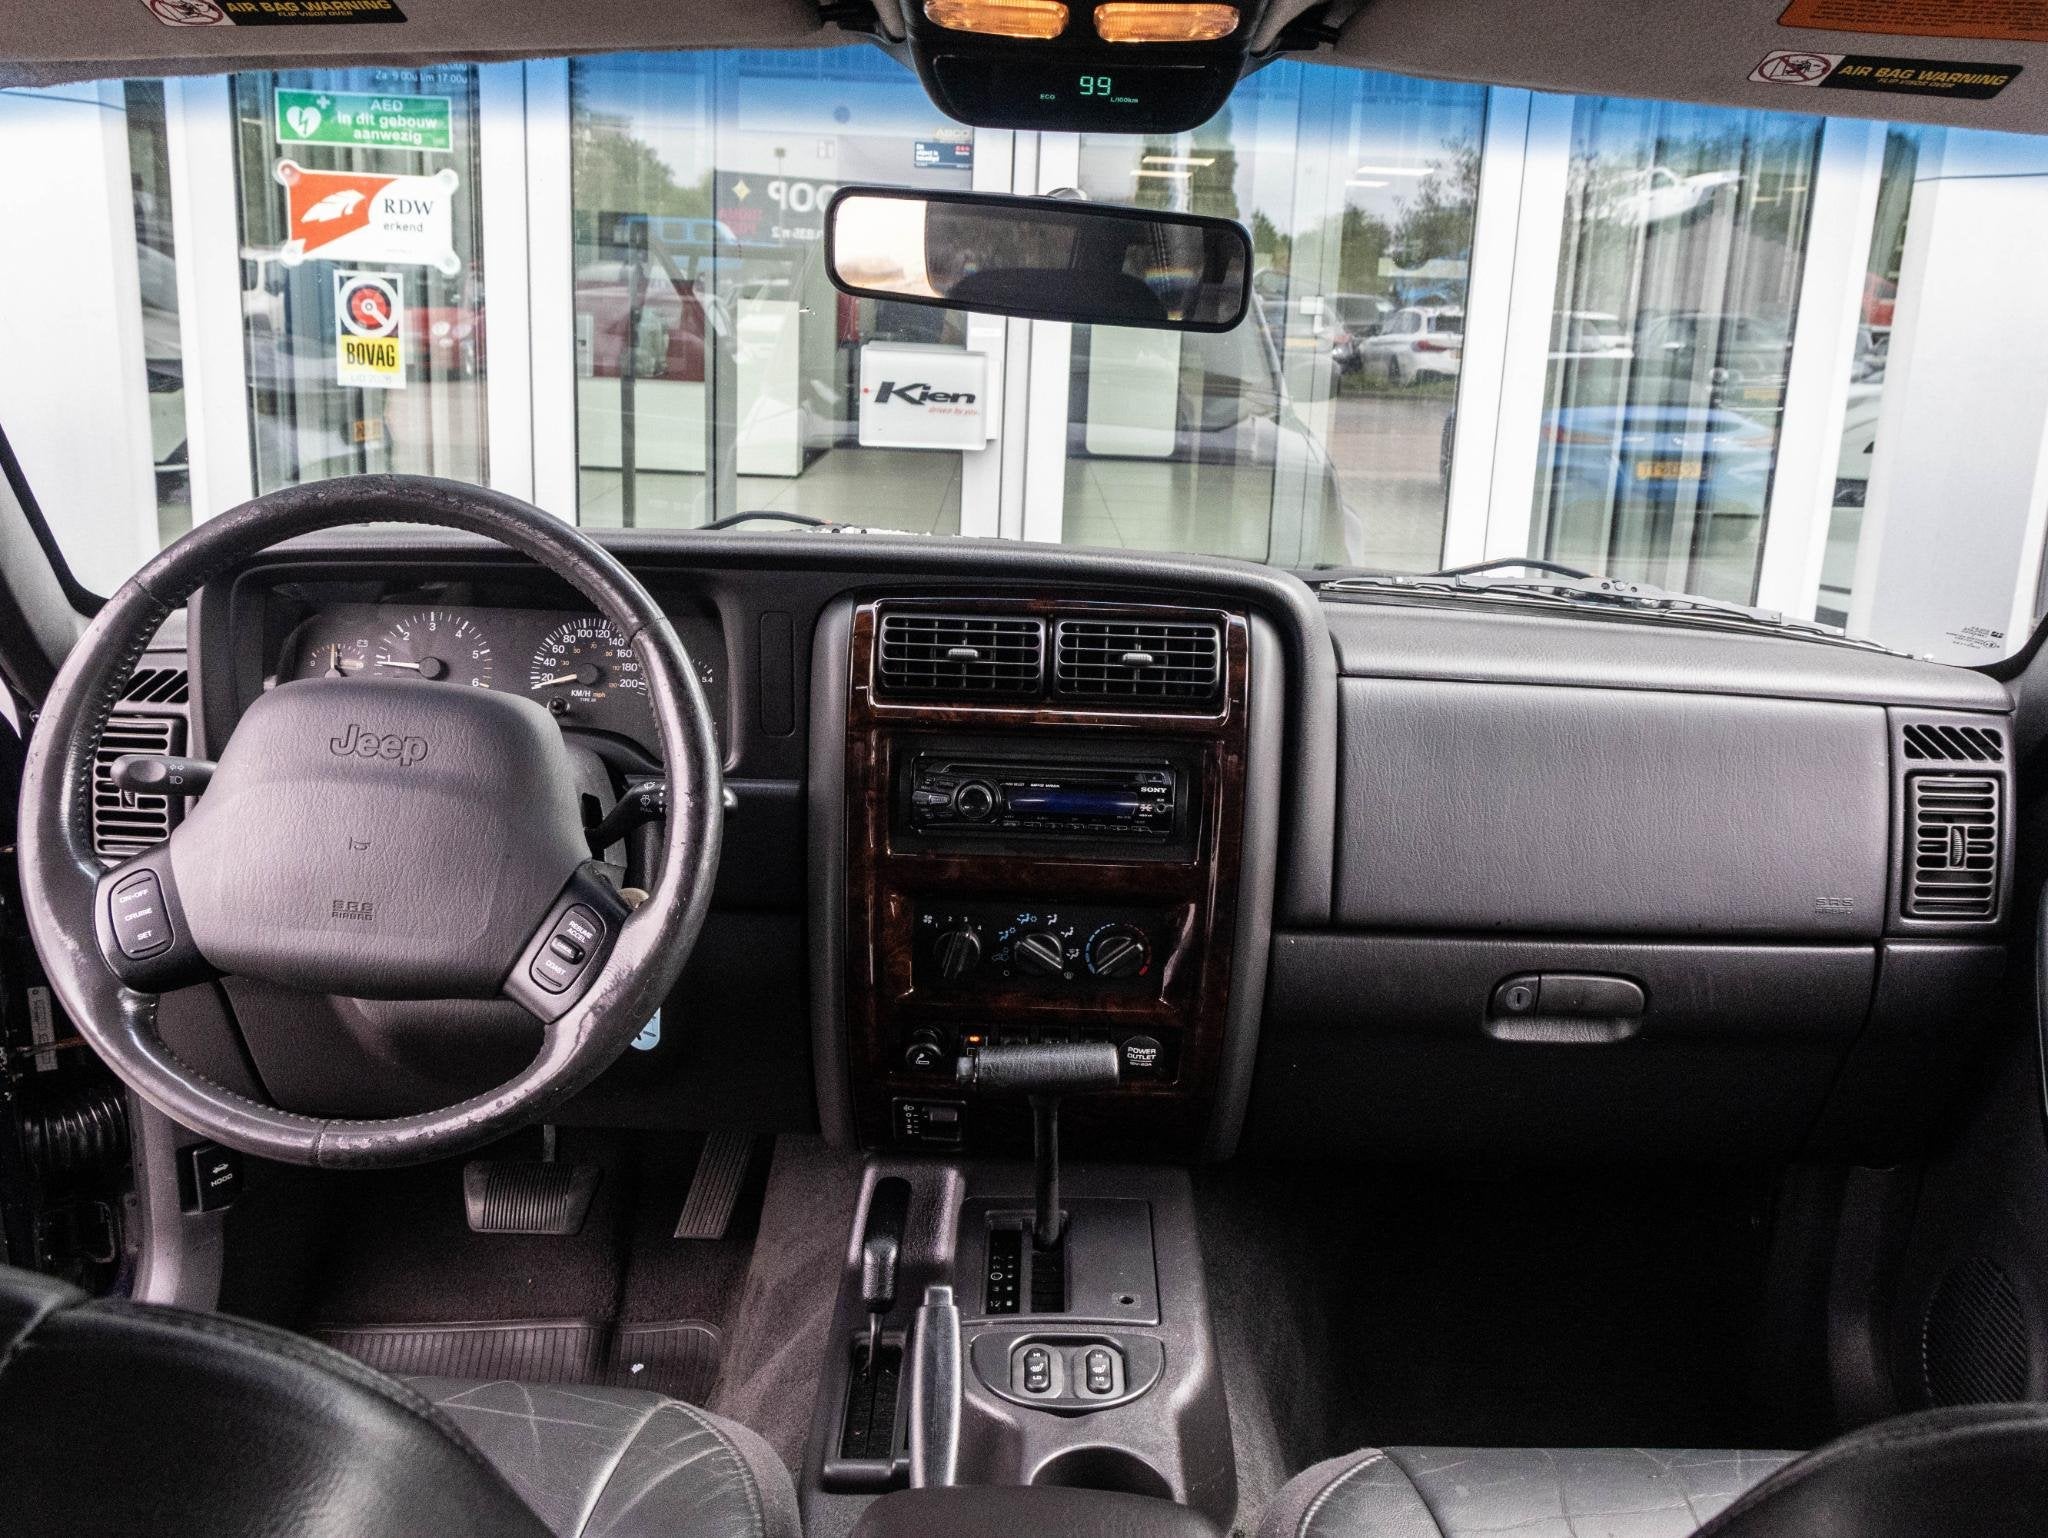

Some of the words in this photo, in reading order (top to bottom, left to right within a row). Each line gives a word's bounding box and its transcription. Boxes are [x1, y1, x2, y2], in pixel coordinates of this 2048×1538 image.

[226, 3, 257, 13] AIR
[259, 2, 299, 12] BAG
[302, 0, 392, 11] WARNING
[1839, 65, 1873, 76] AIR
[1874, 68, 1915, 79] BAG
[1918, 70, 2009, 86] WARNING
[1079, 76, 1112, 96] 99
[370, 100, 404, 113] AED
[356, 112, 375, 126] dit
[379, 114, 438, 131] gebouw
[353, 130, 422, 145] aanwezig
[384, 199, 434, 216] RDW
[383, 222, 424, 233] erkend
[346, 342, 395, 368] BOVAG
[874, 381, 976, 406] Kien
[429, 623, 437, 631] 3
[403, 632, 410, 641] 2
[455, 630, 463, 639] 4
[576, 628, 593, 638] 100
[595, 629, 610, 639] 120
[562, 634, 576, 644] 80
[608, 638, 625, 647] 140
[472, 650, 480, 659] 5
[552, 645, 565, 654] 60
[616, 649, 632, 658] 160
[543, 657, 557, 668] 40
[621, 662, 638, 672] 180
[541, 672, 554, 682] 20
[471, 678, 480, 687] 6
[619, 679, 638, 688] 200
[571, 689, 592, 698] KM/H
[329, 723, 429, 767] Jeep
[1140, 786, 1168, 794] SONY
[1815, 897, 1853, 906] SRS
[124, 907, 153, 922] CRUISE
[137, 930, 152, 940] SET
[568, 920, 594, 940] RESUME
[566, 927, 586, 944] ACCEL
[545, 959, 567, 976] COAST
[1127, 1046, 1157, 1054] POWER
[1126, 1052, 1157, 1060] OUTLET
[210, 1173, 233, 1187] HOOD
